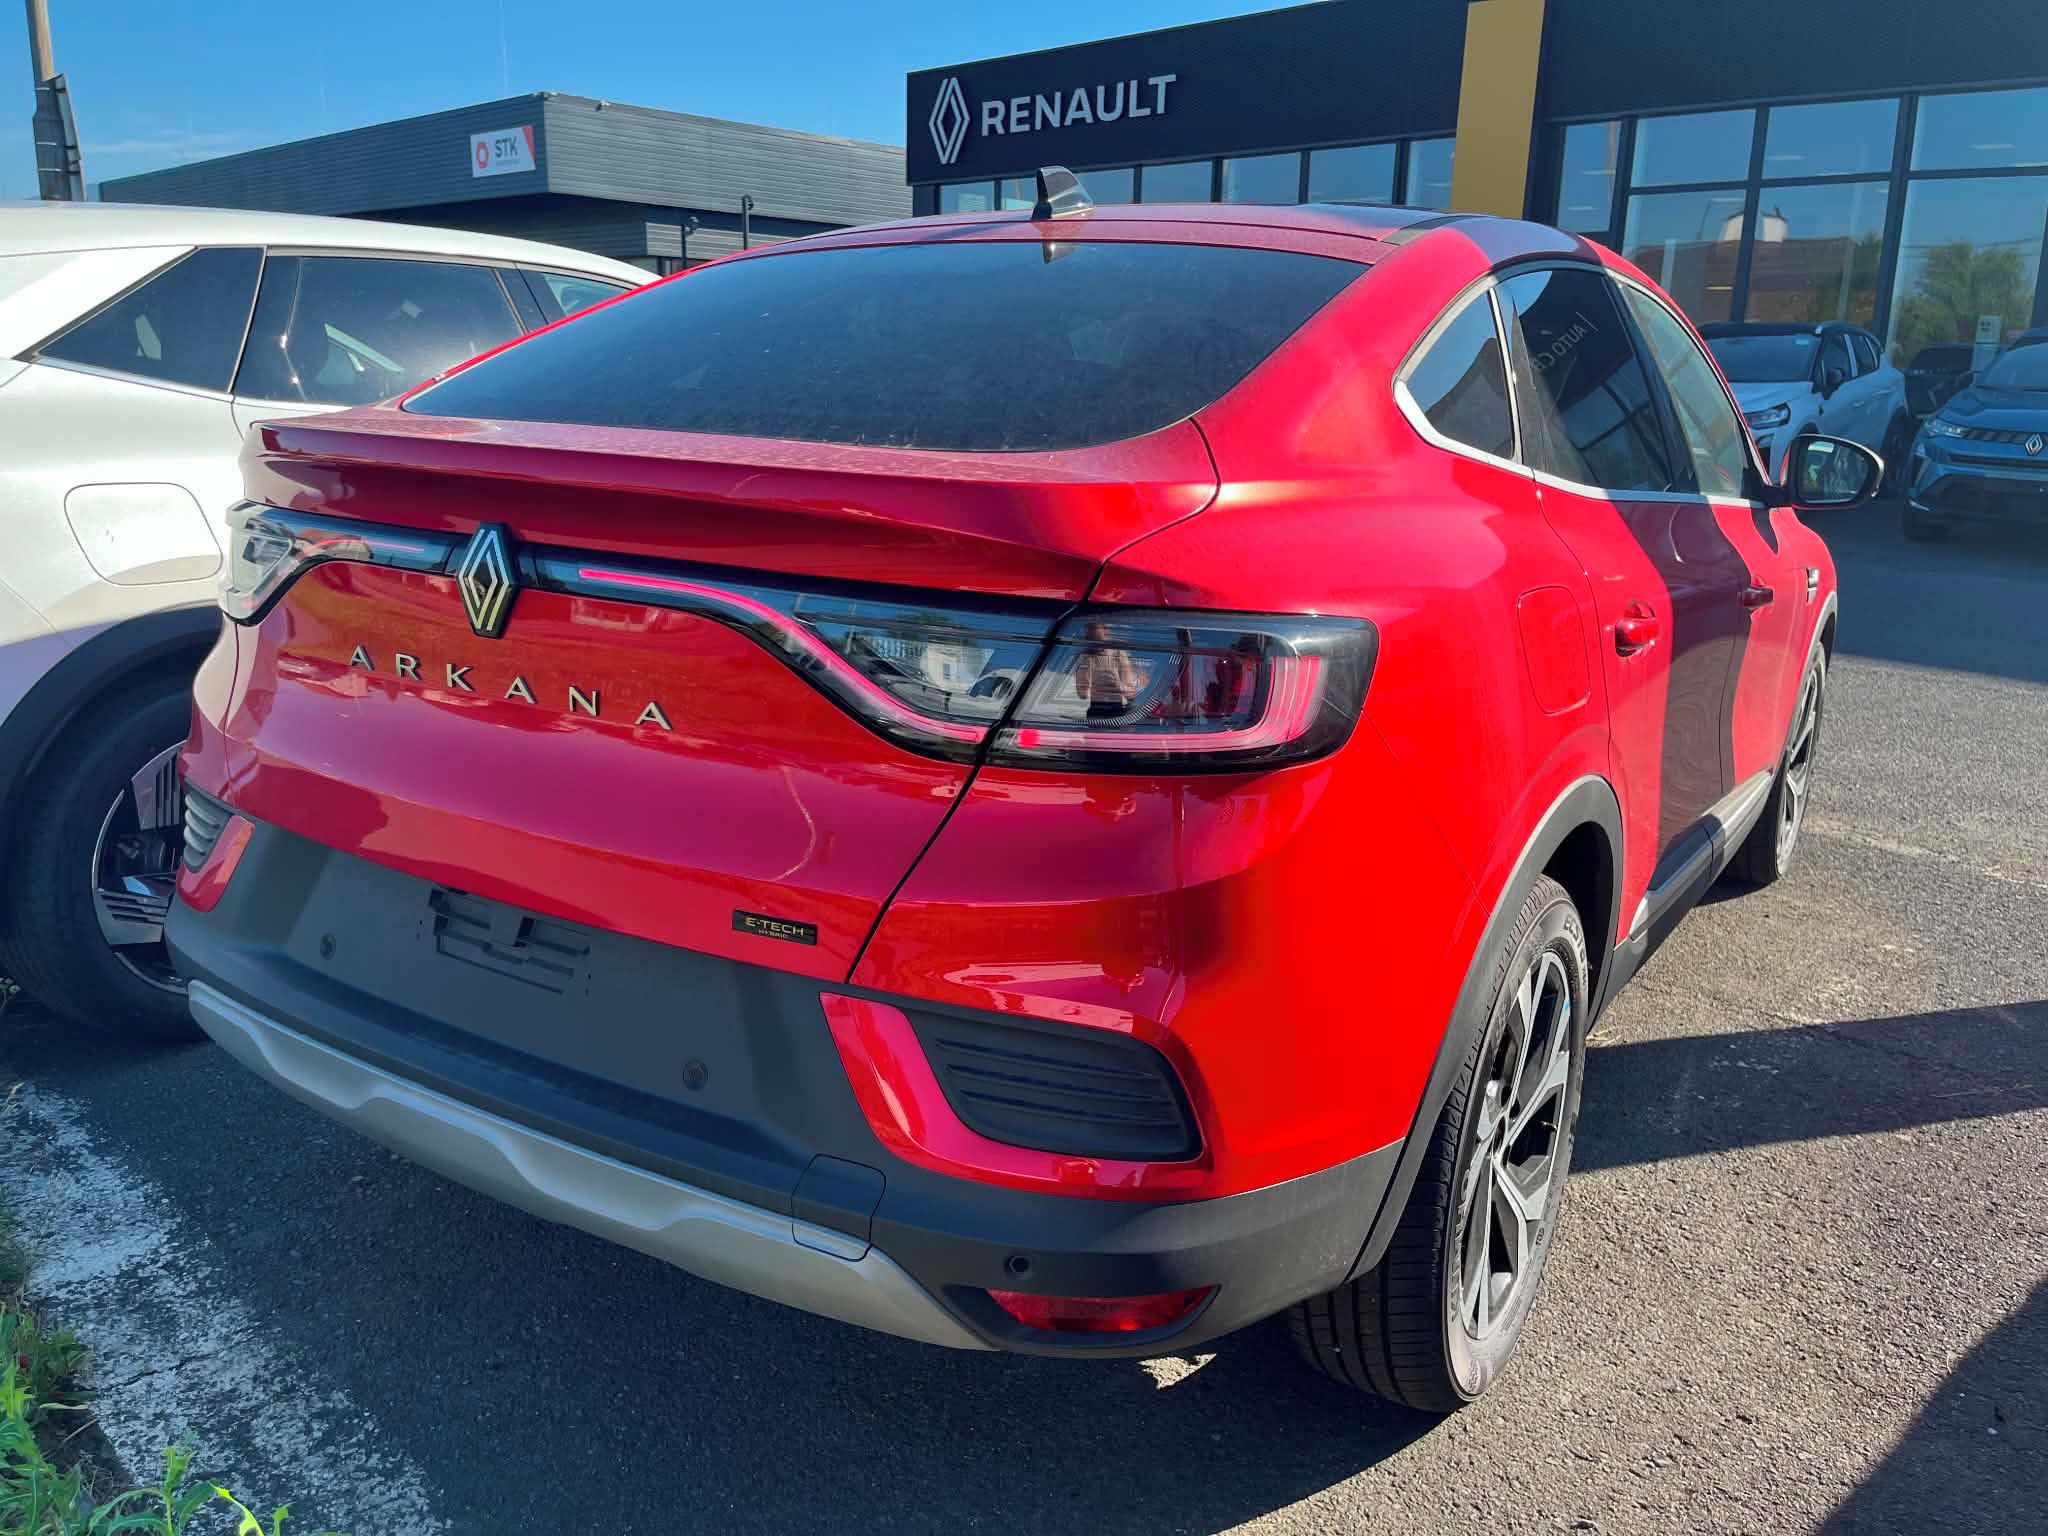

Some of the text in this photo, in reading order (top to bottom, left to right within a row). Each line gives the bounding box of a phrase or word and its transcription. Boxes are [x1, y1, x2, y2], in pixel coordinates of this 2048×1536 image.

[981, 74, 1177, 136] RENAULT
[495, 136, 518, 158] STK
[351, 645, 672, 730] ARKANA
[744, 917, 804, 936] E-TECH
